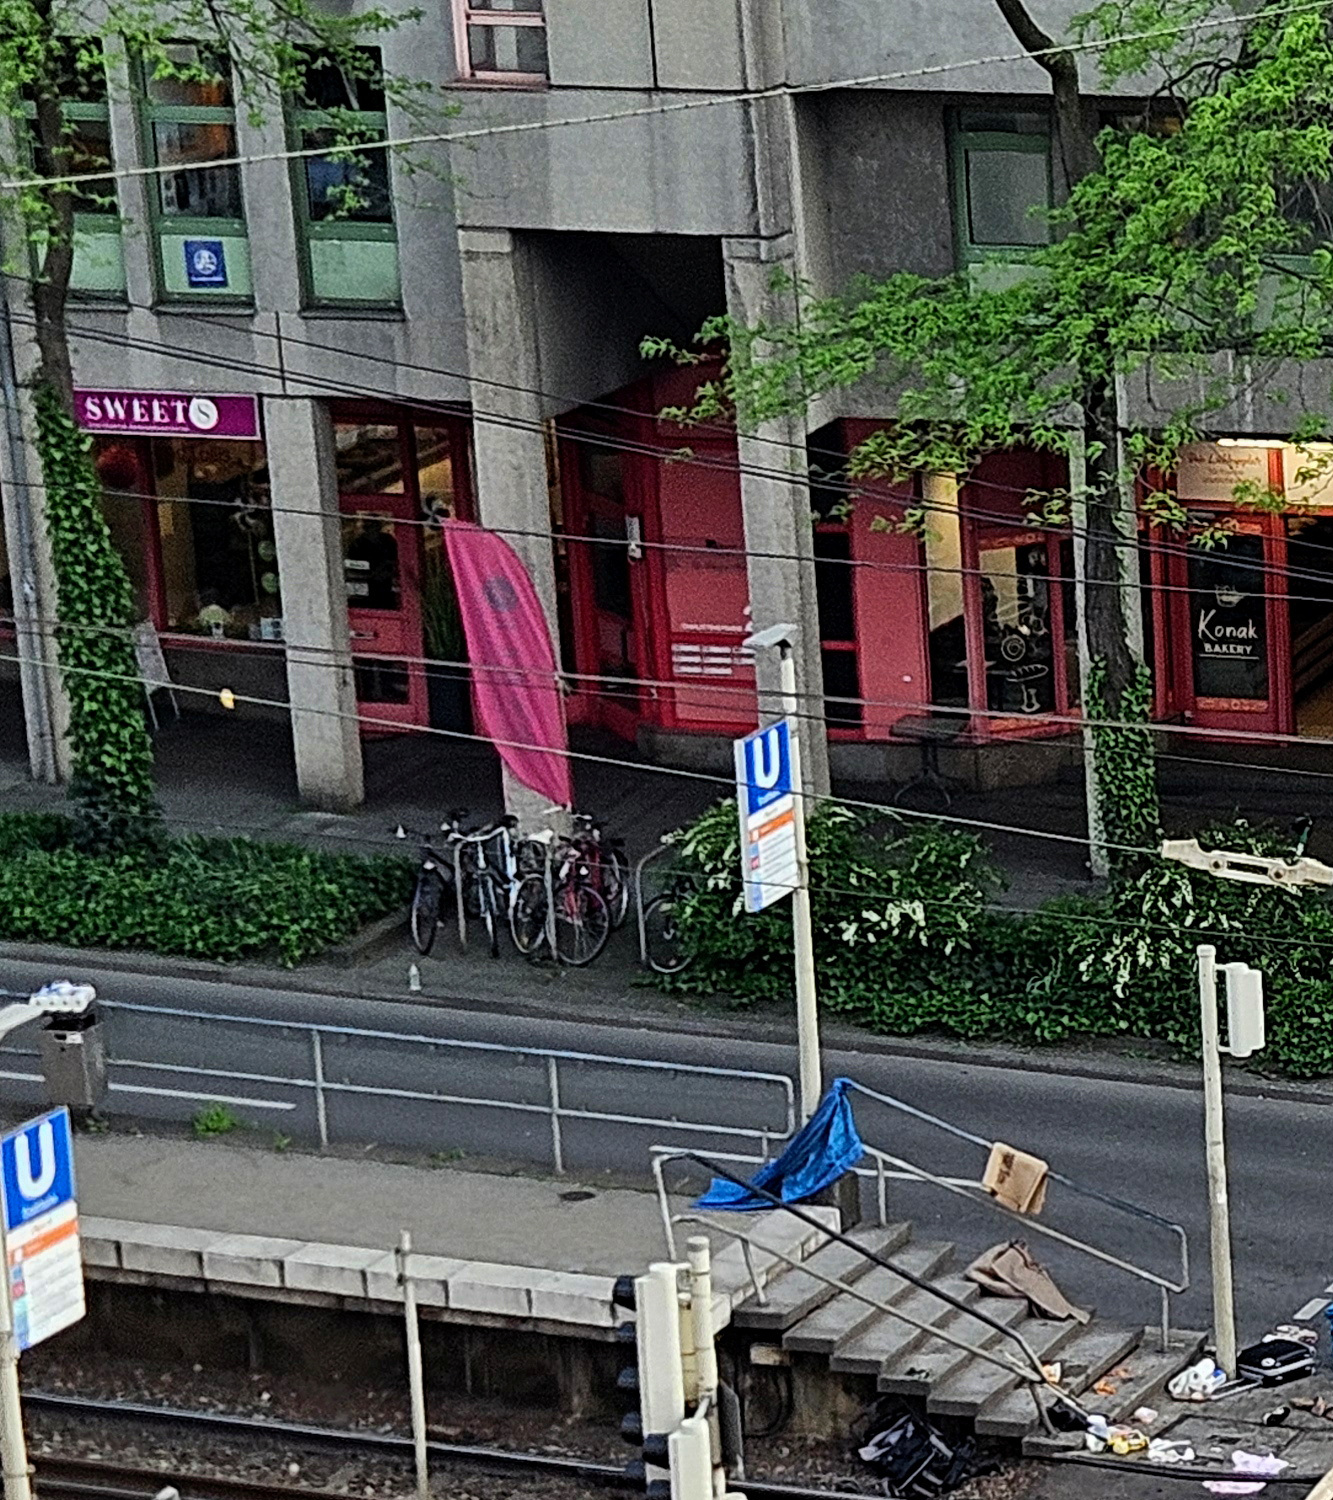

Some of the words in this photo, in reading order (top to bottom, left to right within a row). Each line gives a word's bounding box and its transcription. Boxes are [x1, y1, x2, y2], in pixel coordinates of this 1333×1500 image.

[1198, 608, 1258, 641] Konak
[1204, 643, 1252, 654] BAKERY
[753, 728, 779, 788] U
[15, 1119, 55, 1198] U
